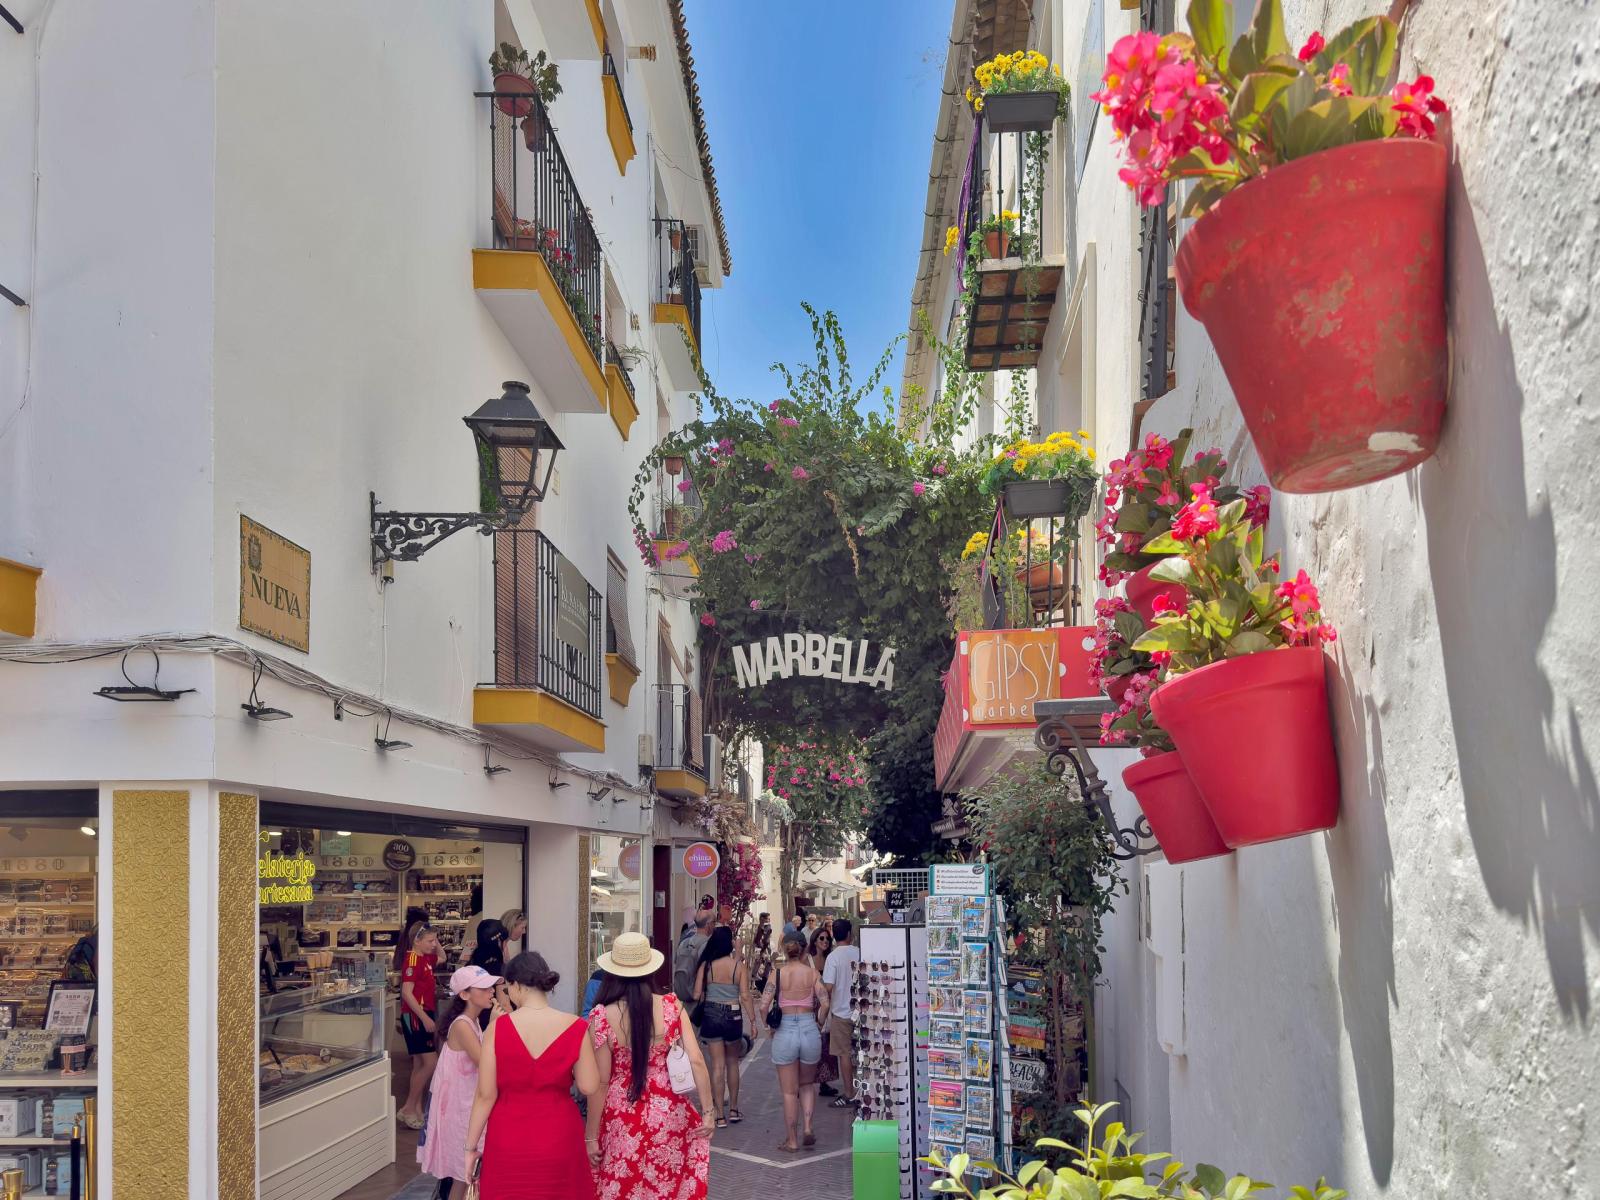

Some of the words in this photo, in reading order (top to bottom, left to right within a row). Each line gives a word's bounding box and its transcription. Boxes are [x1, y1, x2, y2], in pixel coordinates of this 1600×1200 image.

[250, 573, 302, 620] NUEVA
[731, 632, 899, 692] MARBELLA
[973, 703, 1035, 719] marbel
[1, 857, 65, 872] 1880
[321, 856, 374, 868] 1880
[422, 854, 475, 867] 1880
